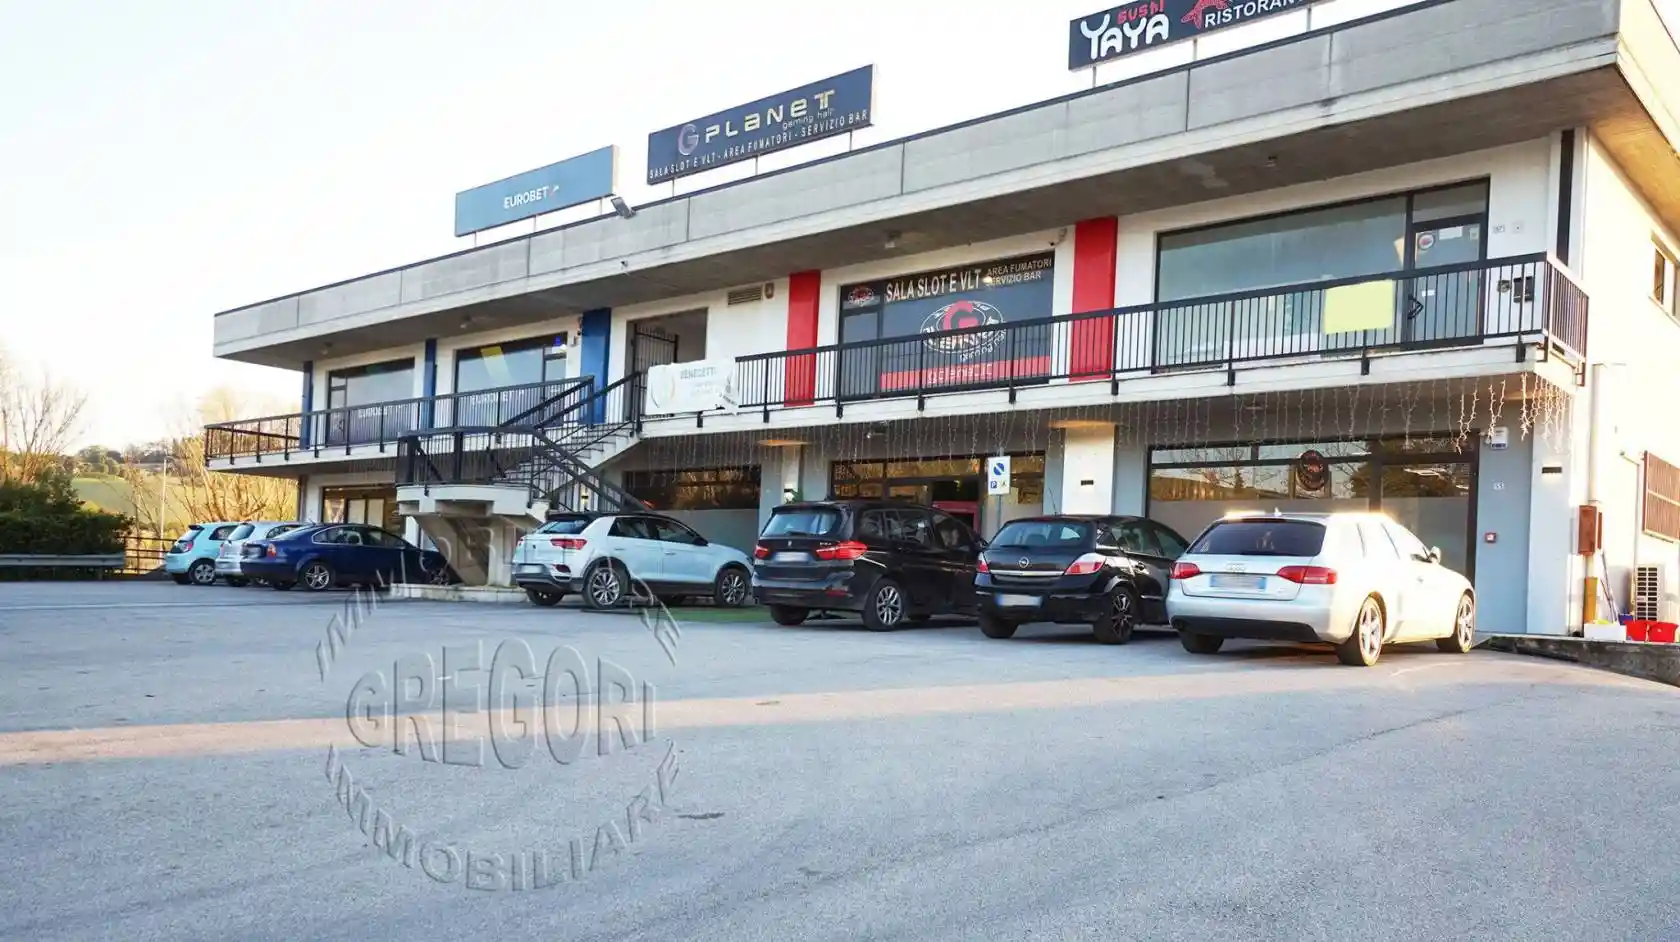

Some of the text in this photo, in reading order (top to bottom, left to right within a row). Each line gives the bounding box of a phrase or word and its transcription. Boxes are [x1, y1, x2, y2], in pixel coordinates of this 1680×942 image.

[1080, 13, 1170, 60] YAYA
[649, 165, 669, 179] SALA
[671, 159, 690, 173] SLOT
[693, 156, 698, 168] E
[702, 151, 716, 165] VLT
[724, 143, 745, 159] AREA
[747, 131, 792, 153] FUMATORI
[801, 116, 845, 138] SERVIZIO
[848, 108, 868, 124] BAR
[503, 185, 550, 209] EUROBET
[986, 271, 1042, 285] ERVIZIO BAR
[987, 258, 1052, 278] AREA FUMATORI
[885, 281, 917, 302] SALA
[917, 273, 947, 297] SLOT
[949, 273, 957, 293] E
[960, 268, 982, 291] VLT
